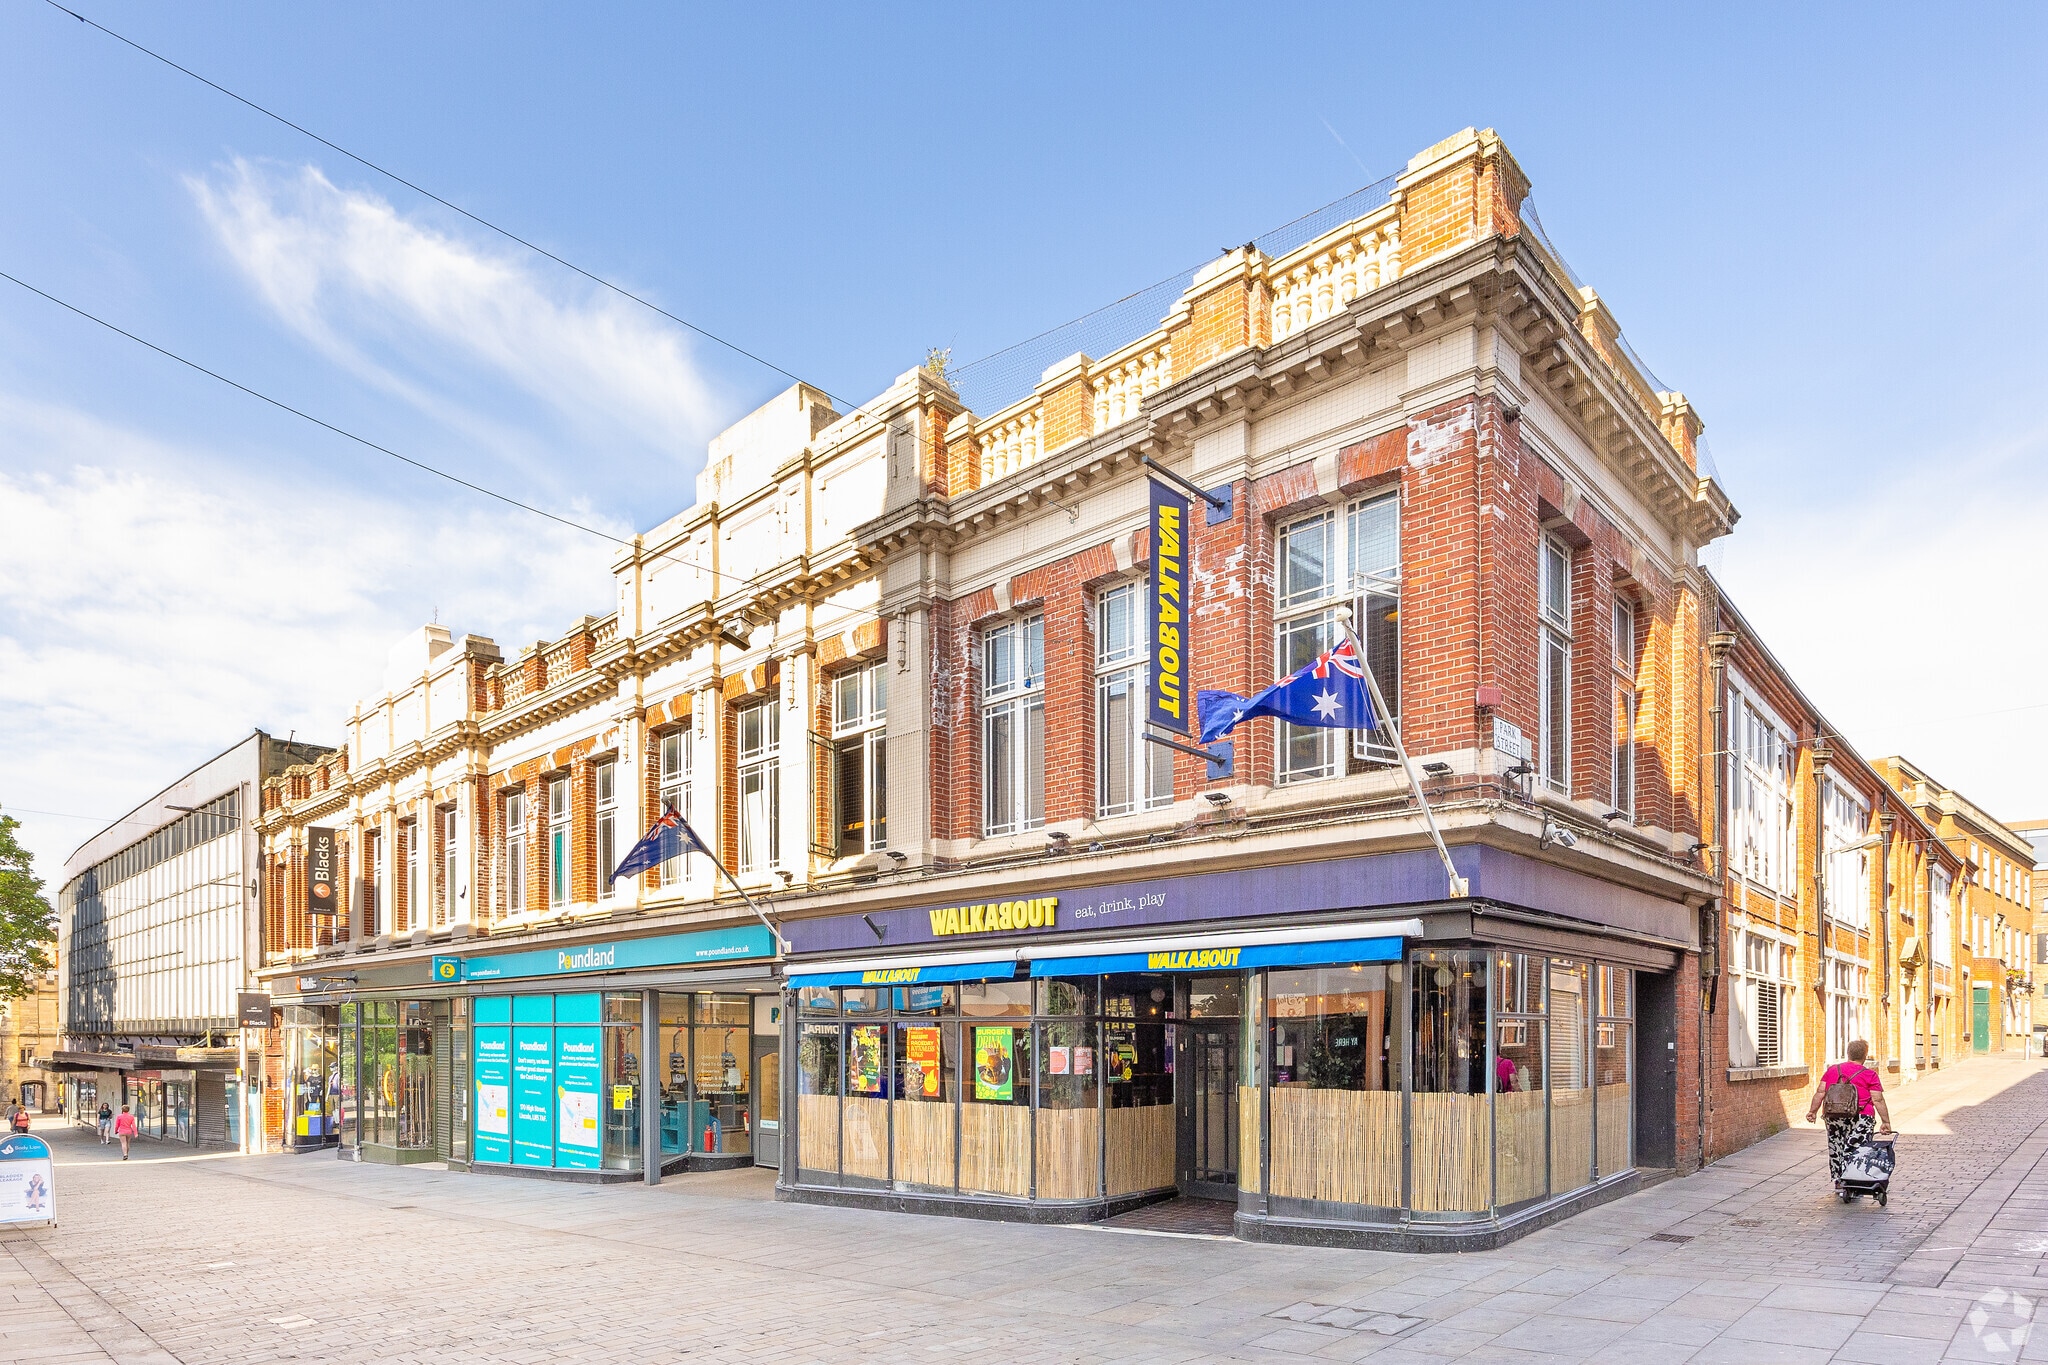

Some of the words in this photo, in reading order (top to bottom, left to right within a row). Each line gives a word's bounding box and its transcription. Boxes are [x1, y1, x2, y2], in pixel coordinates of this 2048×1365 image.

[1158, 505, 1180, 719] WALKABOUT
[1500, 721, 1516, 740] PARK
[1496, 735, 1520, 756] STREET
[315, 836, 329, 881] Blacks
[929, 897, 1058, 936] WALKABOUT
[1075, 907, 1097, 919] eat,
[1100, 898, 1136, 915] drink,
[1139, 893, 1167, 910] play
[558, 945, 615, 970] Poundland
[695, 945, 750, 958] www.poundland.co.uk
[1147, 948, 1241, 970] WALKABOUT
[861, 967, 921, 984] WALKABOUT
[519, 1041, 548, 1051] Poundland
[563, 1042, 595, 1053] Poundland
[977, 1036, 1003, 1049] DRINK
